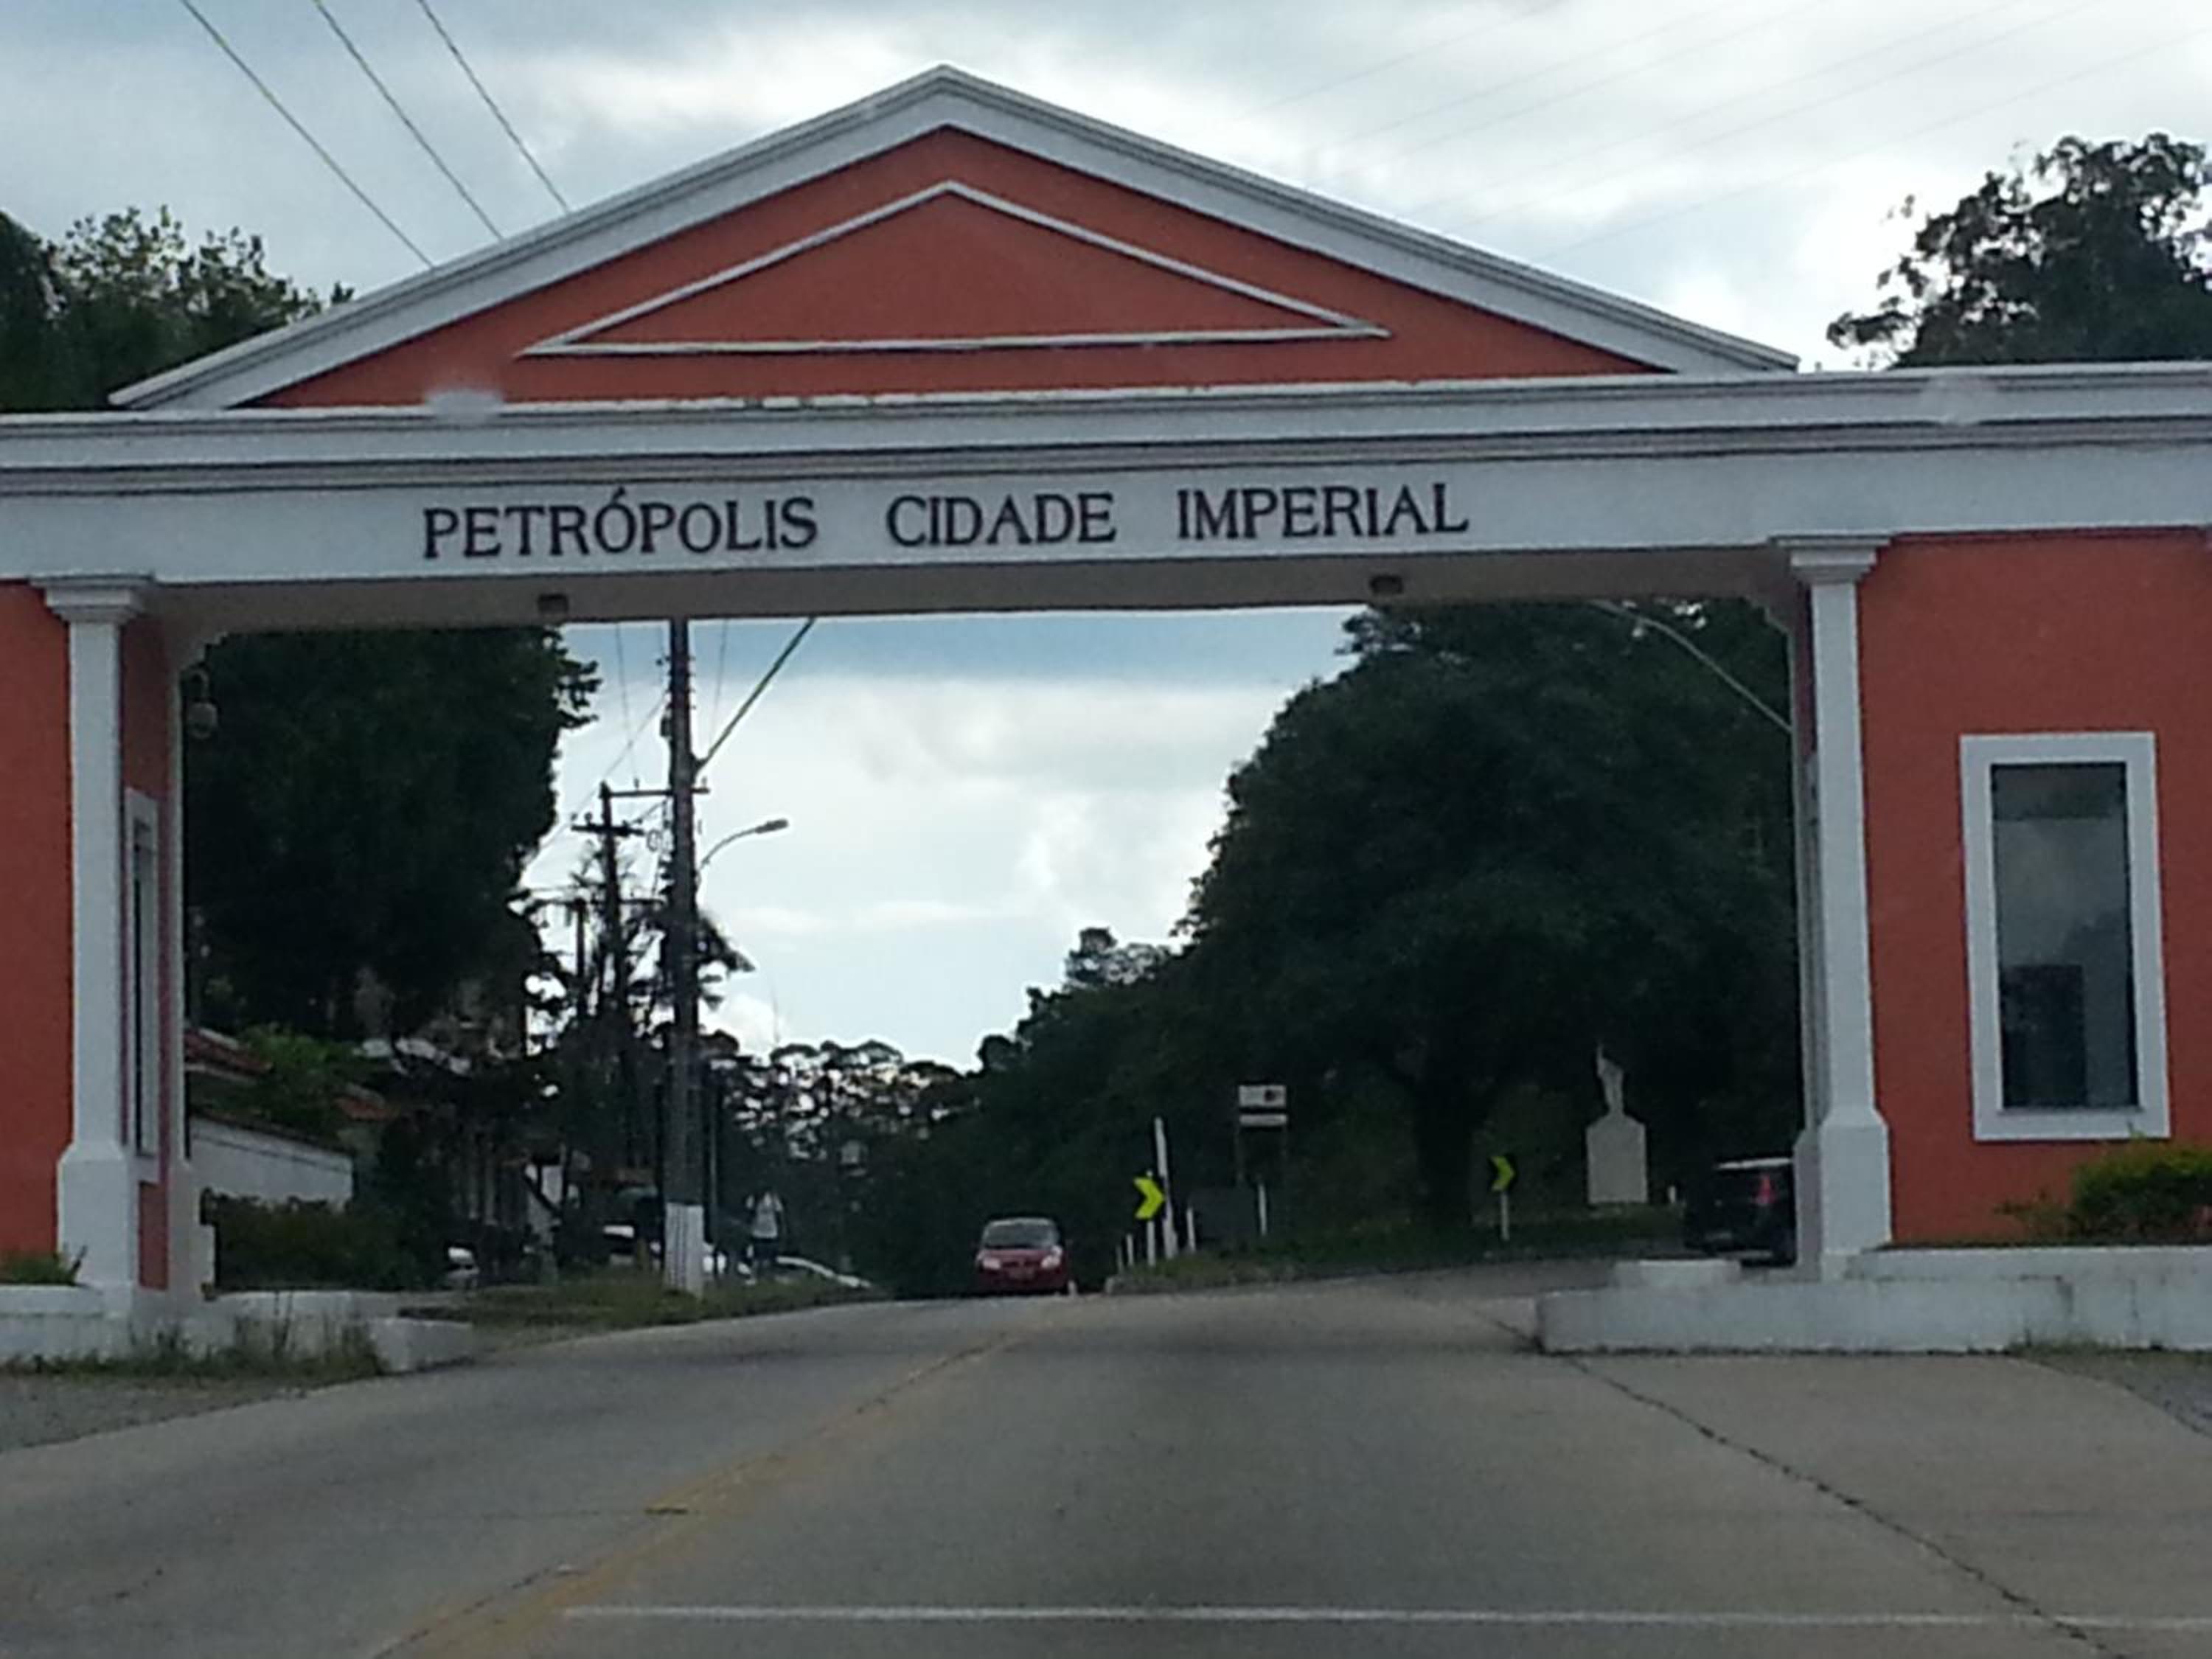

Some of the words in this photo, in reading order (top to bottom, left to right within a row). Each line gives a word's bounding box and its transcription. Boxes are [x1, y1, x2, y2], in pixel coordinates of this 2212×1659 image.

[423, 487, 818, 559] PETRÓPOLIS
[887, 492, 1116, 548] CIDADE
[1178, 483, 1470, 541] IMPERIAL
